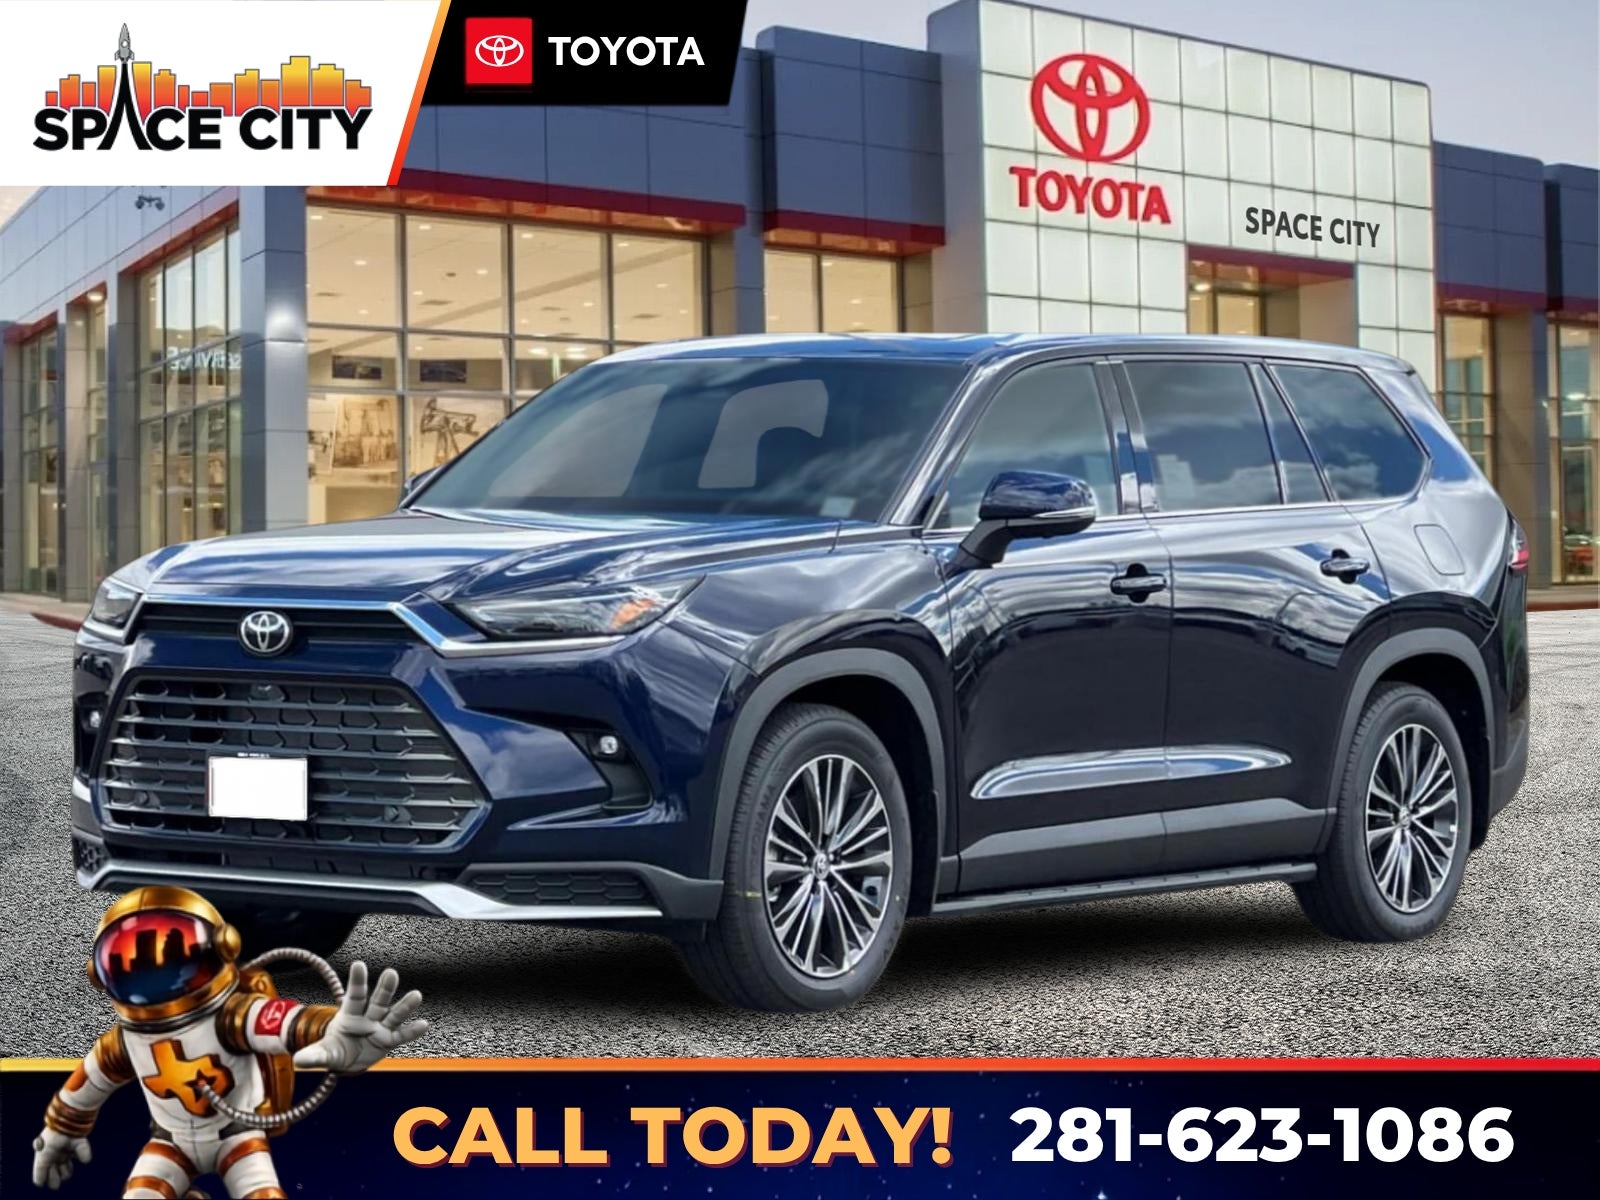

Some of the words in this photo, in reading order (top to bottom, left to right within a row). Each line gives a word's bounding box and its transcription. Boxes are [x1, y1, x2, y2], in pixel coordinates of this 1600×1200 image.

[1009, 166, 1171, 224] TOYOTA
[1245, 206, 1323, 242] SPACE
[1329, 218, 1381, 248] CITY
